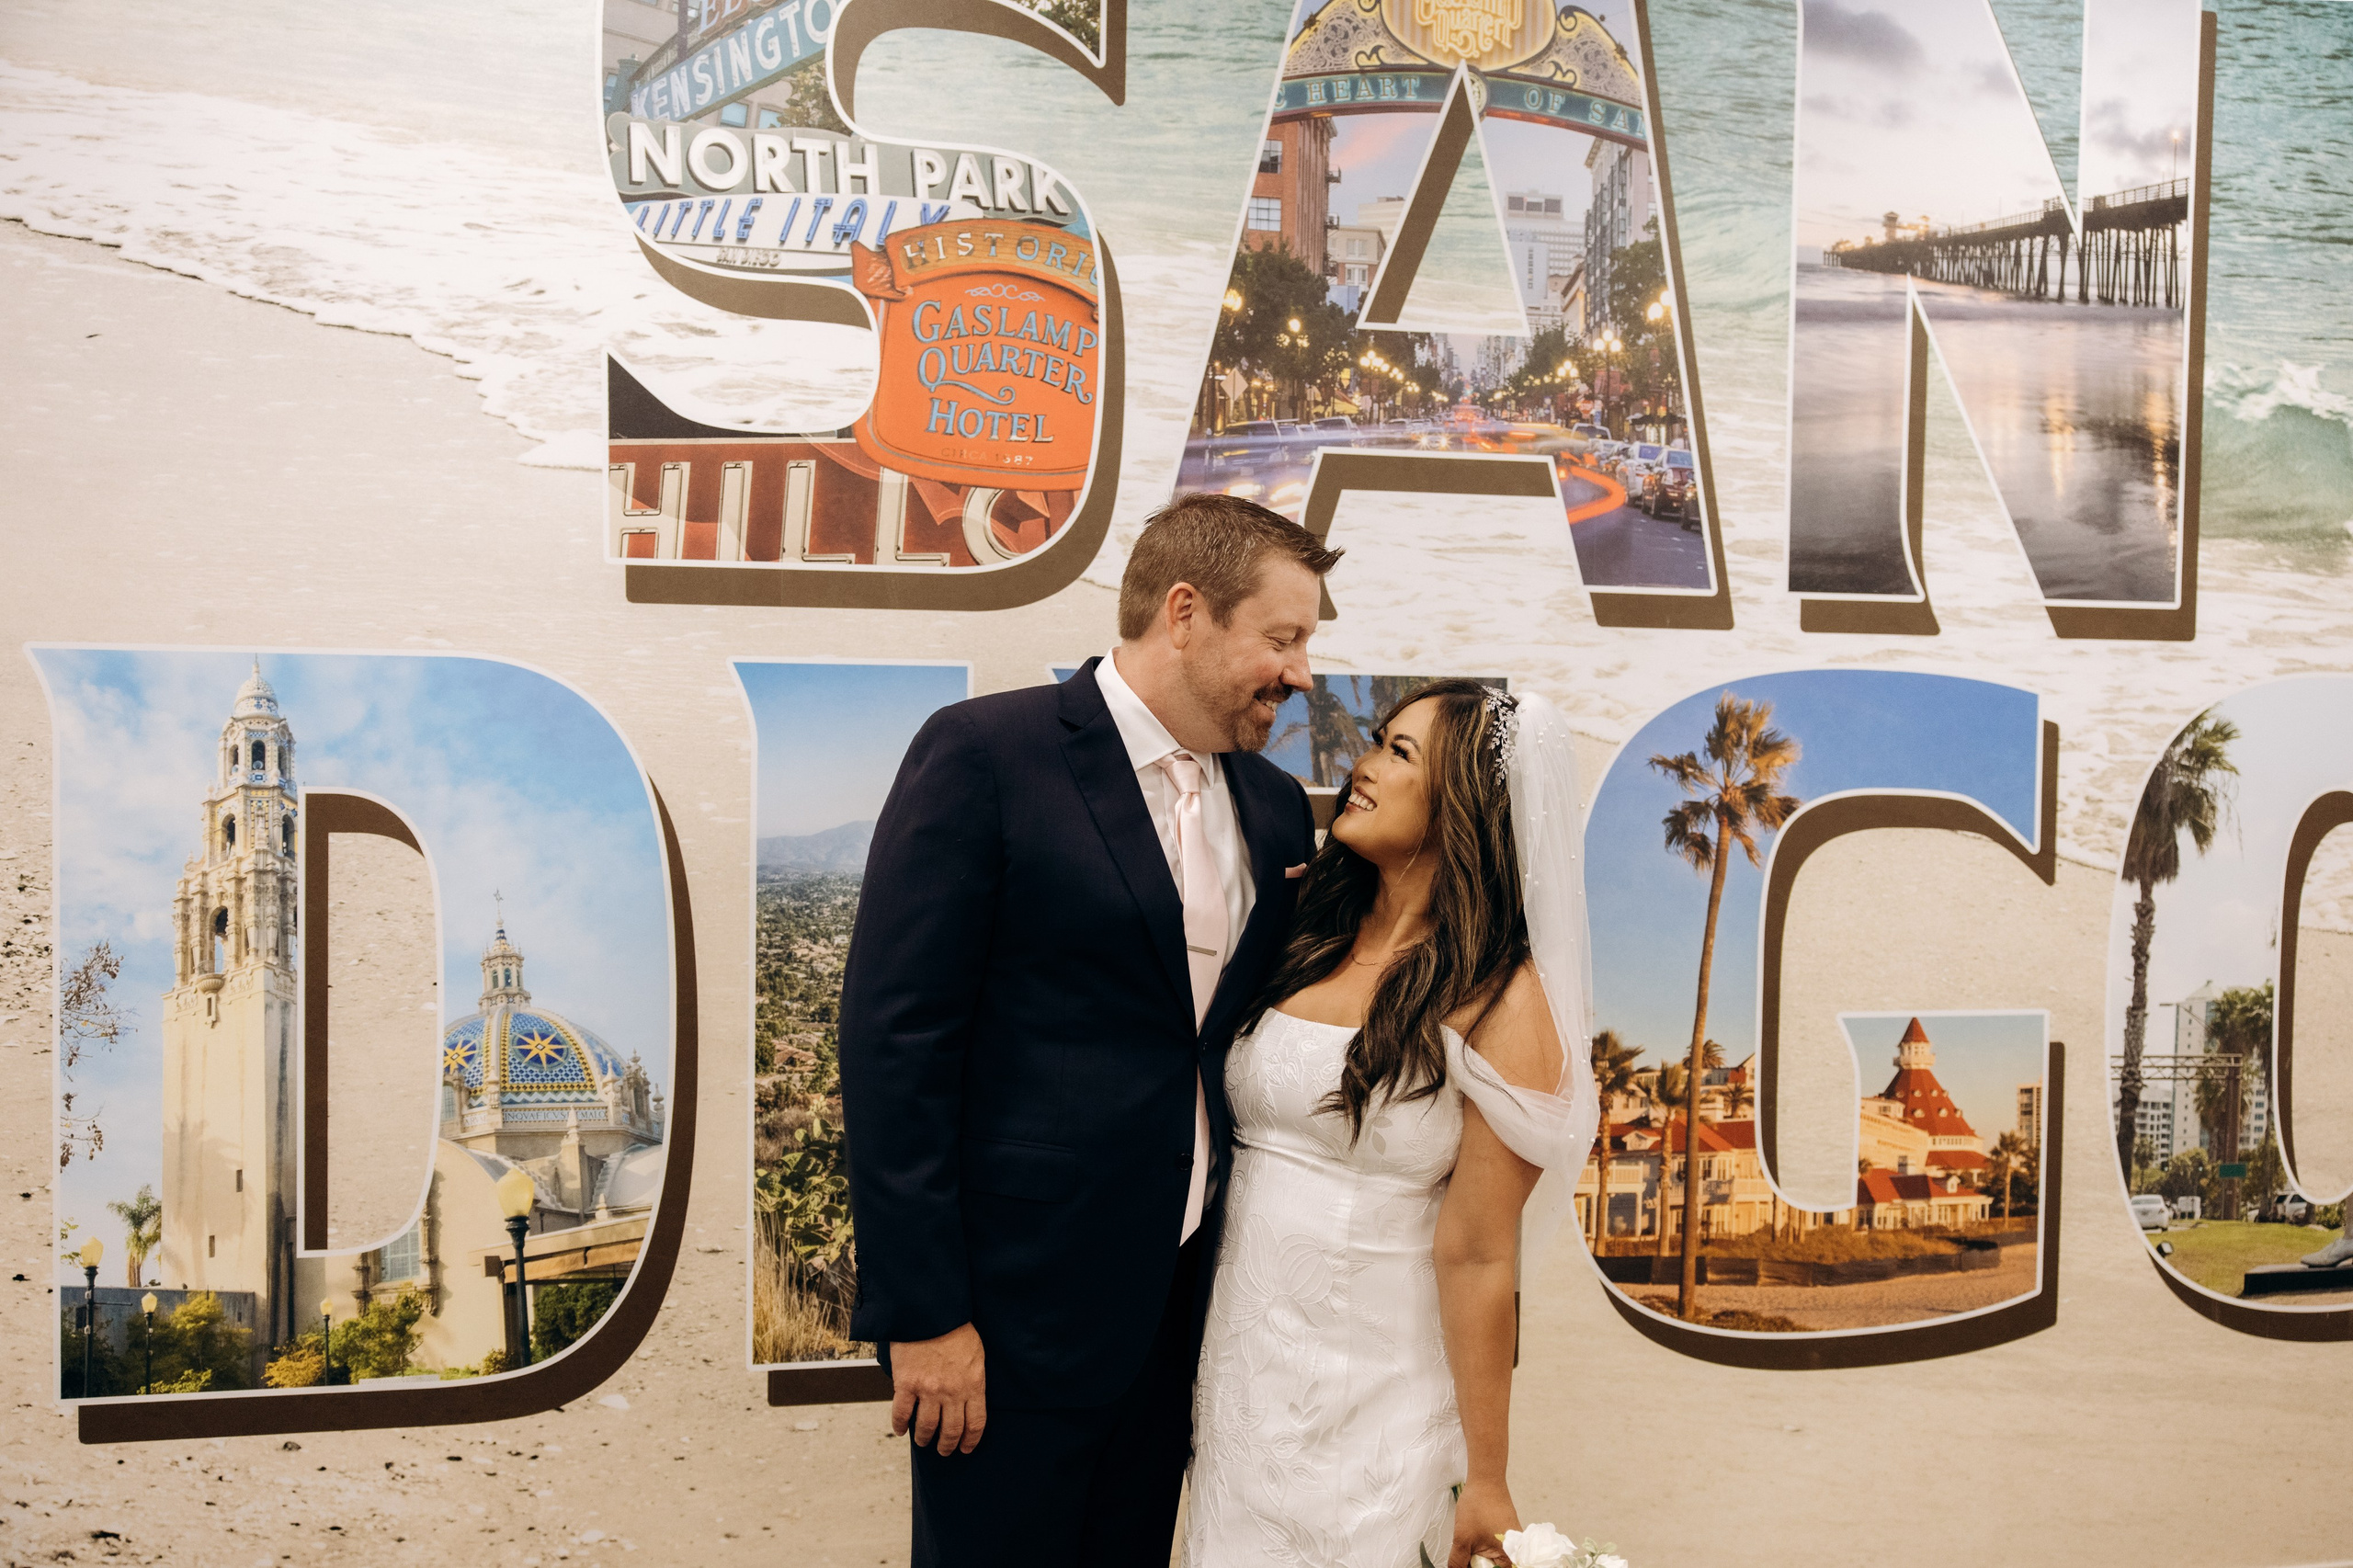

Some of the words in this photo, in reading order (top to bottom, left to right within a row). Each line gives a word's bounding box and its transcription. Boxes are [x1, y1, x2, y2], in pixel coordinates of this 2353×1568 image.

[1306, 75, 1421, 105] HEART
[1524, 86, 1565, 115] OF
[628, 121, 881, 198] NORTH
[910, 147, 1072, 216] PARK
[636, 197, 763, 240] LITTLE
[912, 299, 1098, 358] GASLAMP
[917, 341, 1094, 405] QUARTER
[926, 397, 1055, 444] HOTEL
